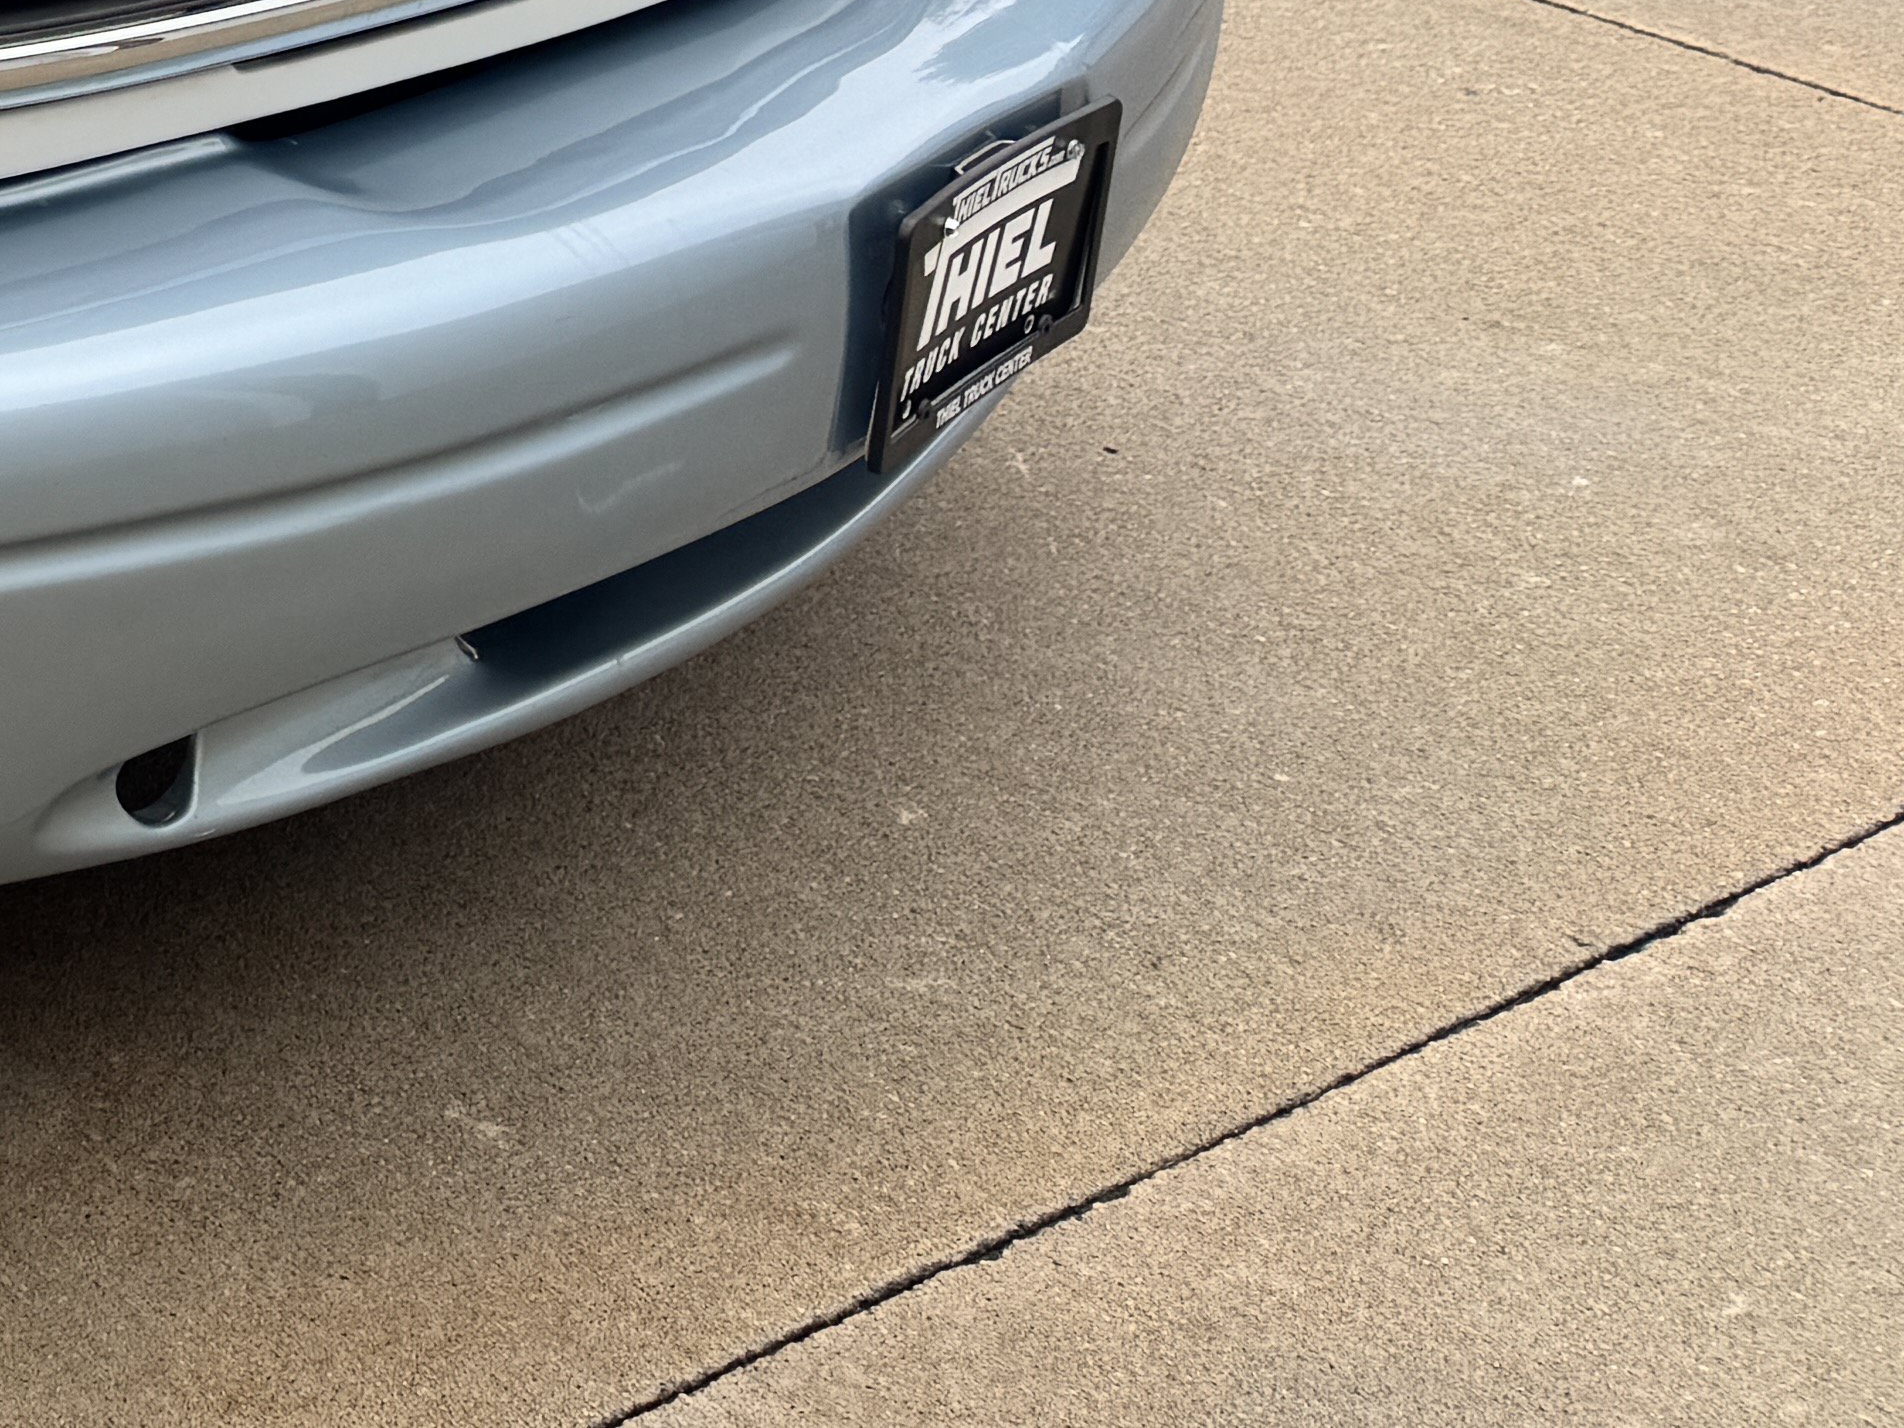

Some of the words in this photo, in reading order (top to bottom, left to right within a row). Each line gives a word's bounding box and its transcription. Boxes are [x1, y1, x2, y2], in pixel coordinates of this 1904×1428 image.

[916, 174, 1070, 351] THIEL
[970, 273, 1054, 348] CENTER
[900, 326, 966, 403] TRUCK
[936, 396, 961, 429] THIEL
[963, 370, 995, 409] TRUCK
[995, 346, 1033, 385] CENTER
